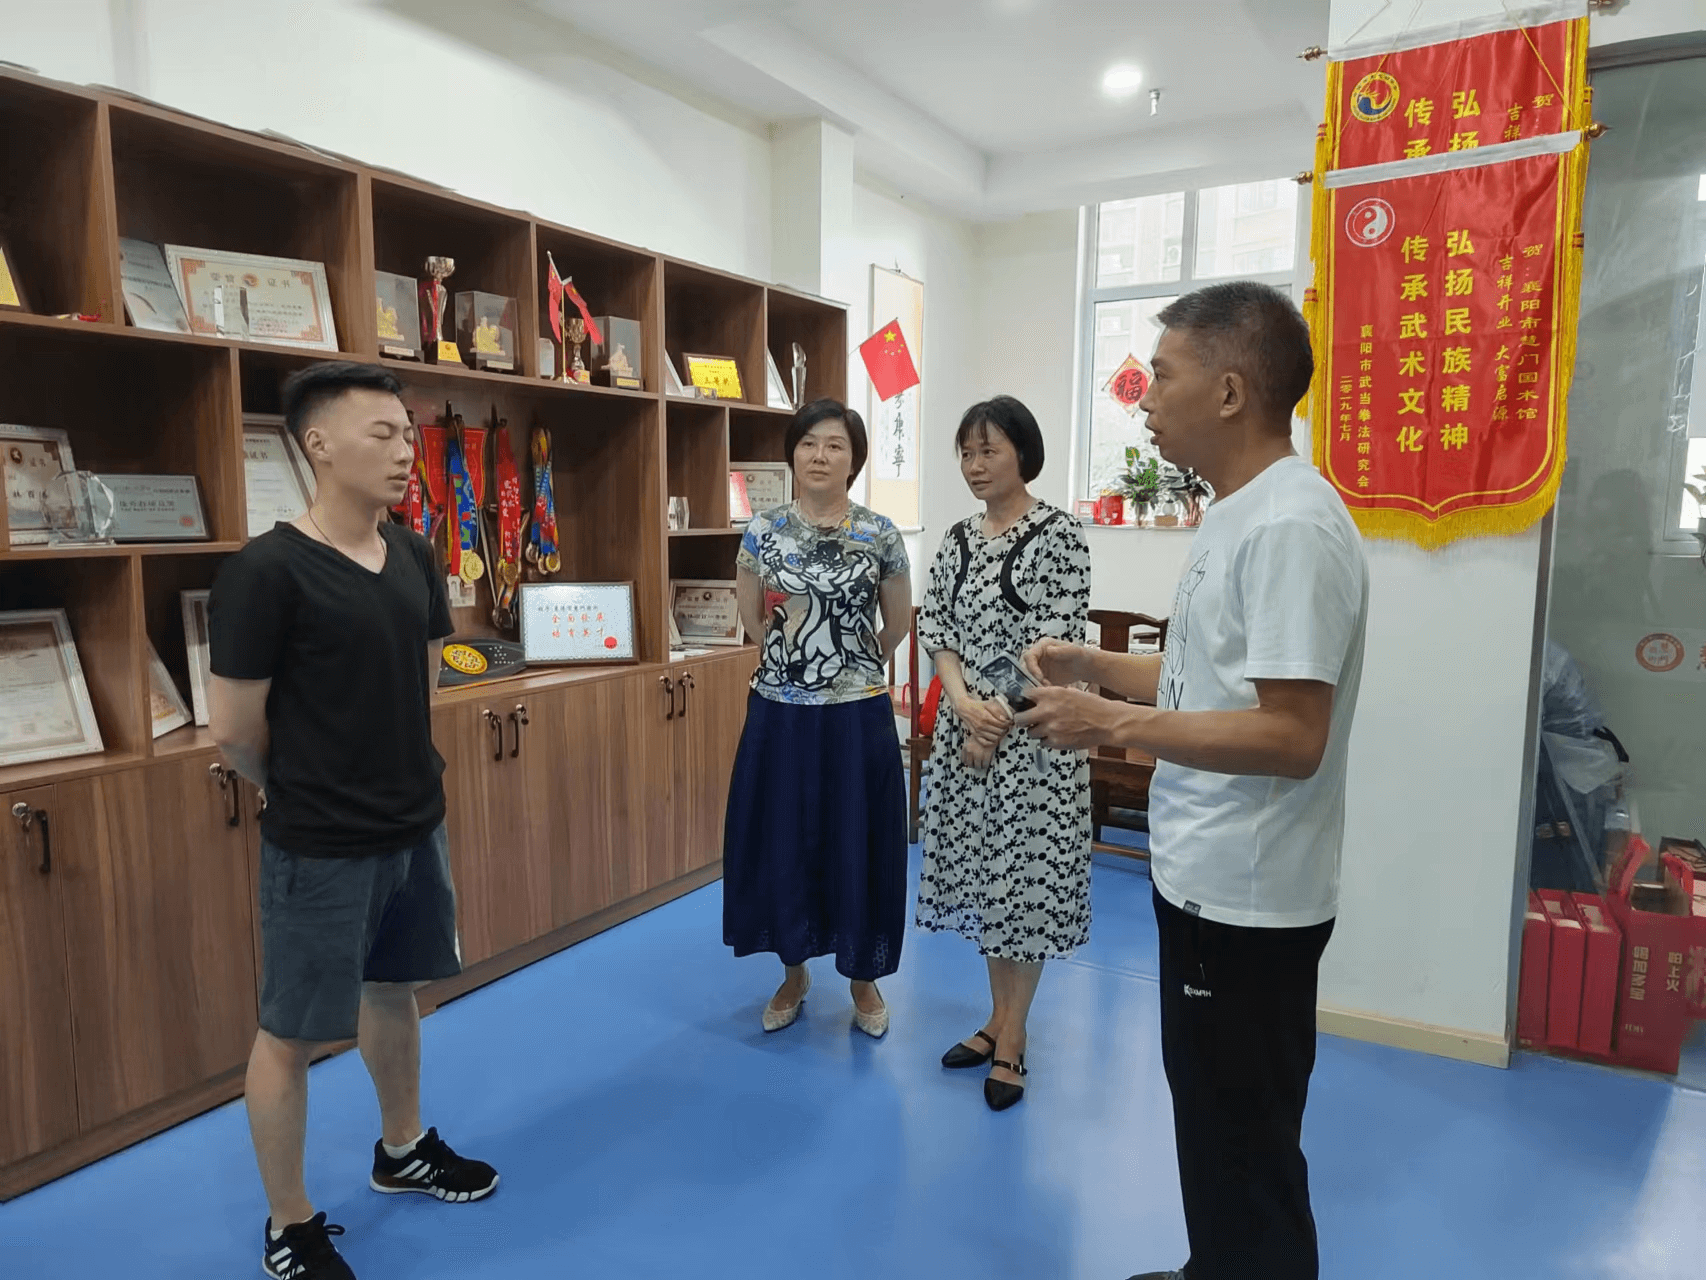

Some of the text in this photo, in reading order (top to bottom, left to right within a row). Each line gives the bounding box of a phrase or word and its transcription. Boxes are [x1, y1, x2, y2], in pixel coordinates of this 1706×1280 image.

[1396, 235, 1429, 452] 传承武术文化
[1440, 229, 1474, 450] 弘扬民族精神
[1496, 254, 1513, 329] 吉祥开业
[1115, 371, 1144, 402] 福
[1340, 375, 1353, 442] 二零一九年七月
[1357, 324, 1373, 487] 襄阳市武当拳法研究会
